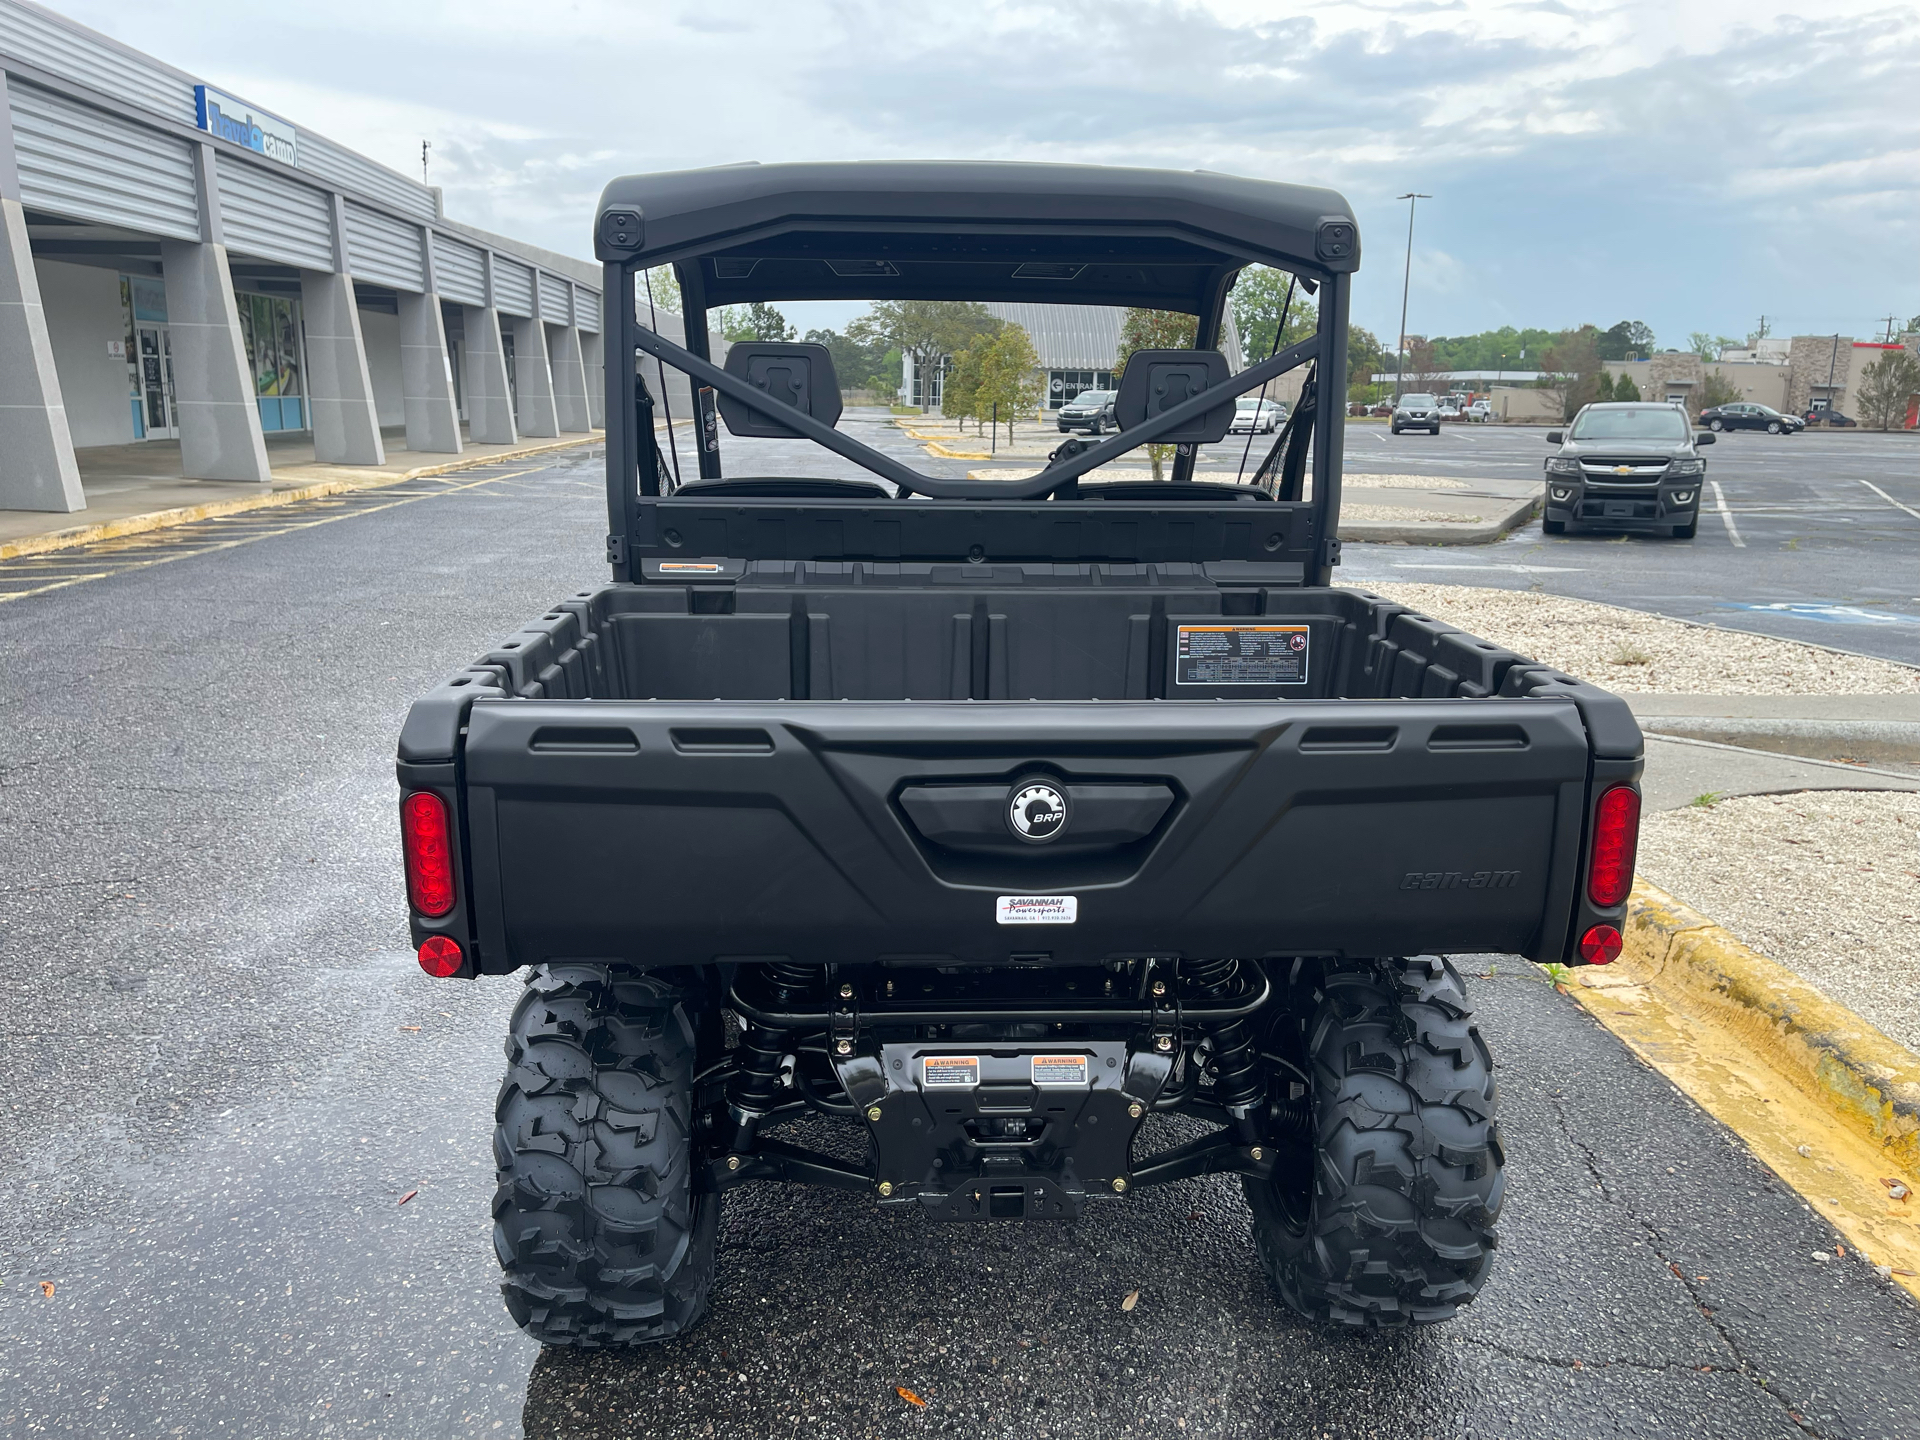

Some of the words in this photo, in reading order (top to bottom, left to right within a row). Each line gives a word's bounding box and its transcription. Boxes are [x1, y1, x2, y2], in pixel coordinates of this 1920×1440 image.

[1066, 382, 1105, 390] ENTRANCE
[1033, 812, 1063, 823] BRP
[1399, 870, 1522, 890] can-am
[1008, 898, 1064, 906] SAVANNAH
[1008, 905, 1065, 916] Powersports
